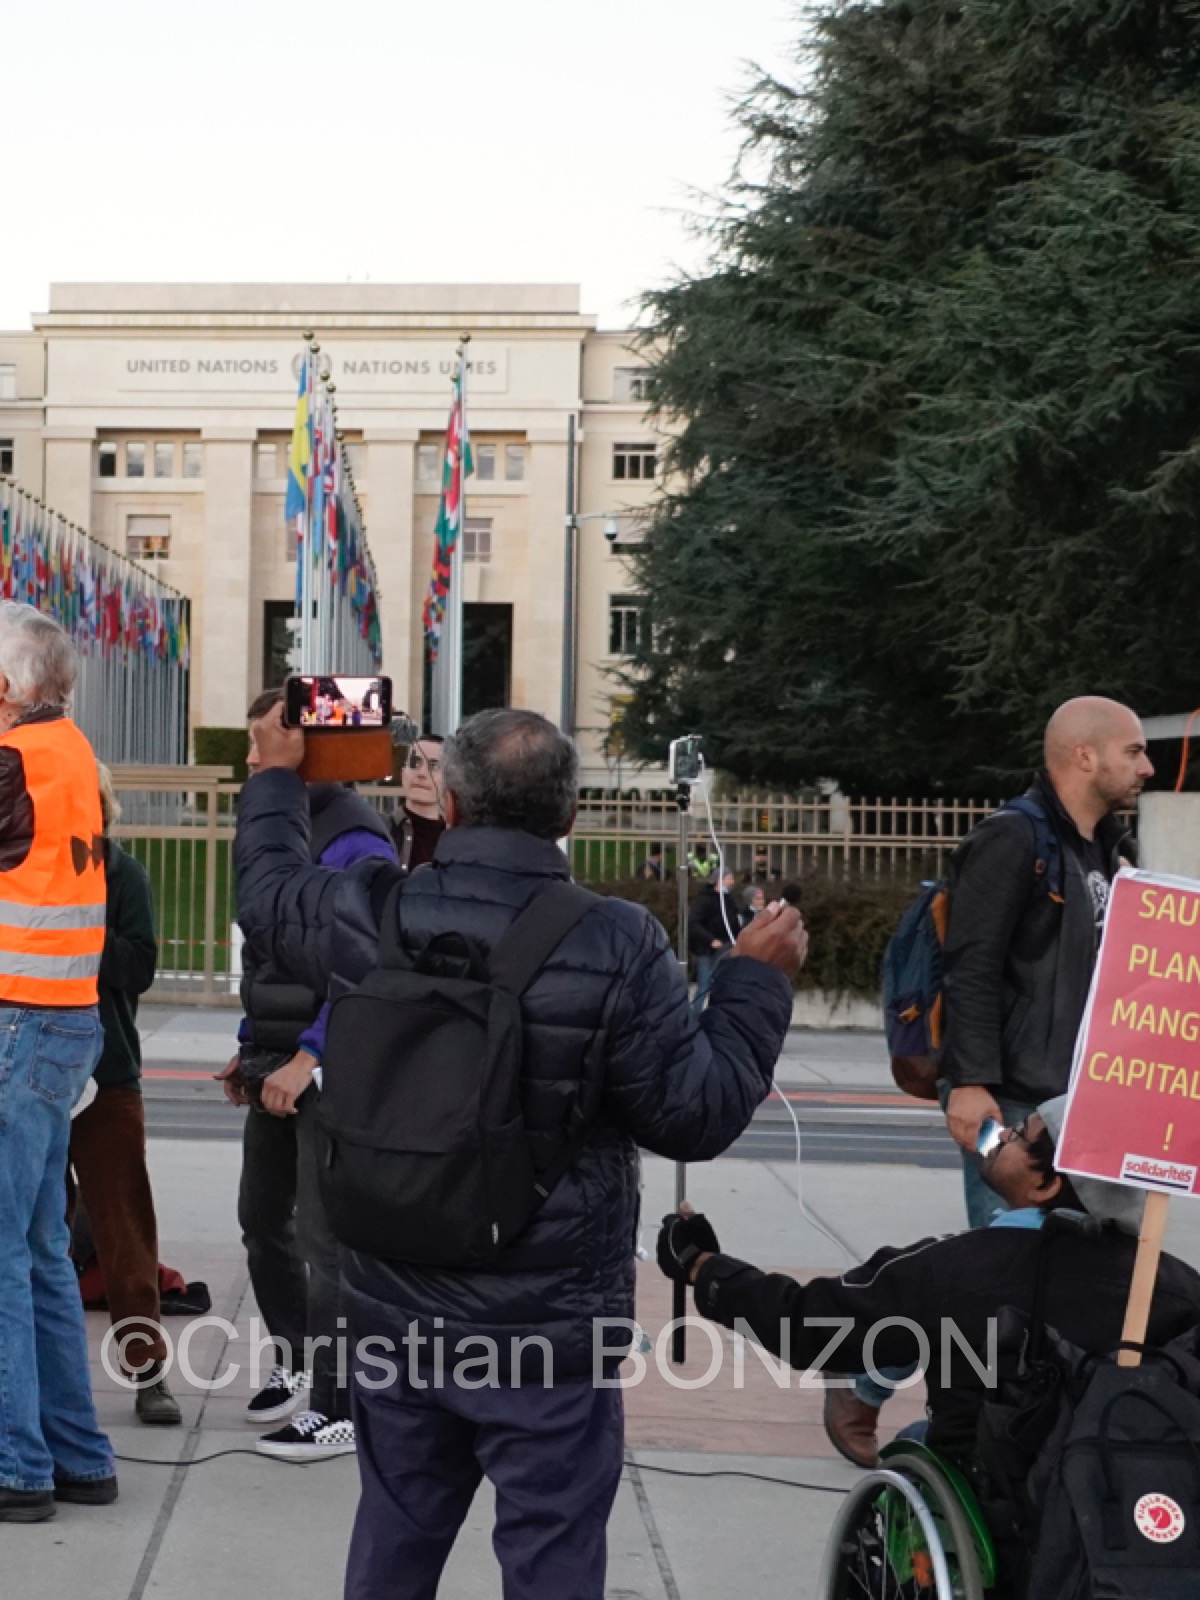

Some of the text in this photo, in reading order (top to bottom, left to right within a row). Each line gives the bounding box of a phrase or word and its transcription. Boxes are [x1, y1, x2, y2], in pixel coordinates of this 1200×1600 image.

[126, 359, 279, 373] UNITED NATIONS
[343, 360, 431, 375] NATIONS
[1163, 1122, 1174, 1151] !
